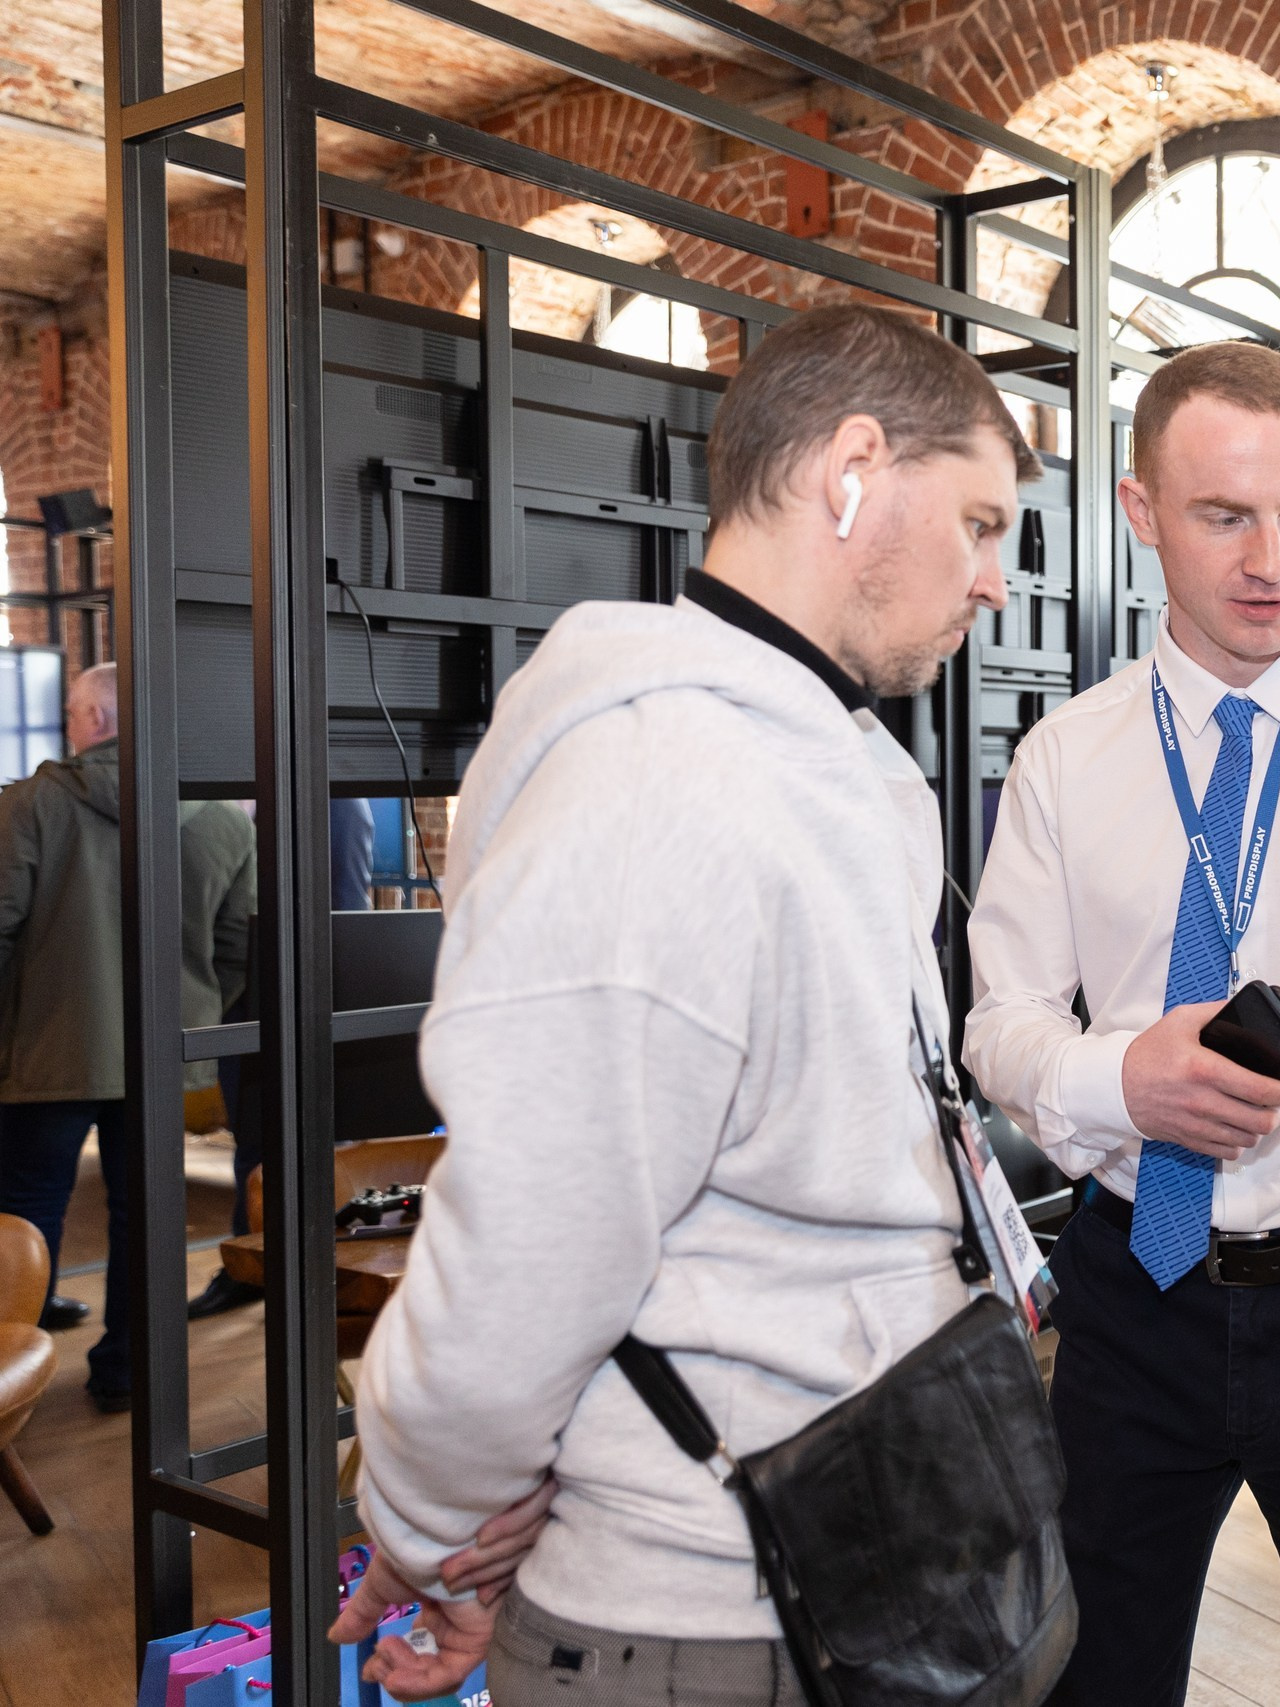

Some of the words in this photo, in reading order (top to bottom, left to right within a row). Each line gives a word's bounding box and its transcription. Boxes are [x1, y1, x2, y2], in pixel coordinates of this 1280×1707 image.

[1157, 692, 1176, 751] PROFDISPLAY
[1244, 827, 1266, 899] PROFDISPLAY
[1204, 866, 1230, 935] PROFDISPLAY
